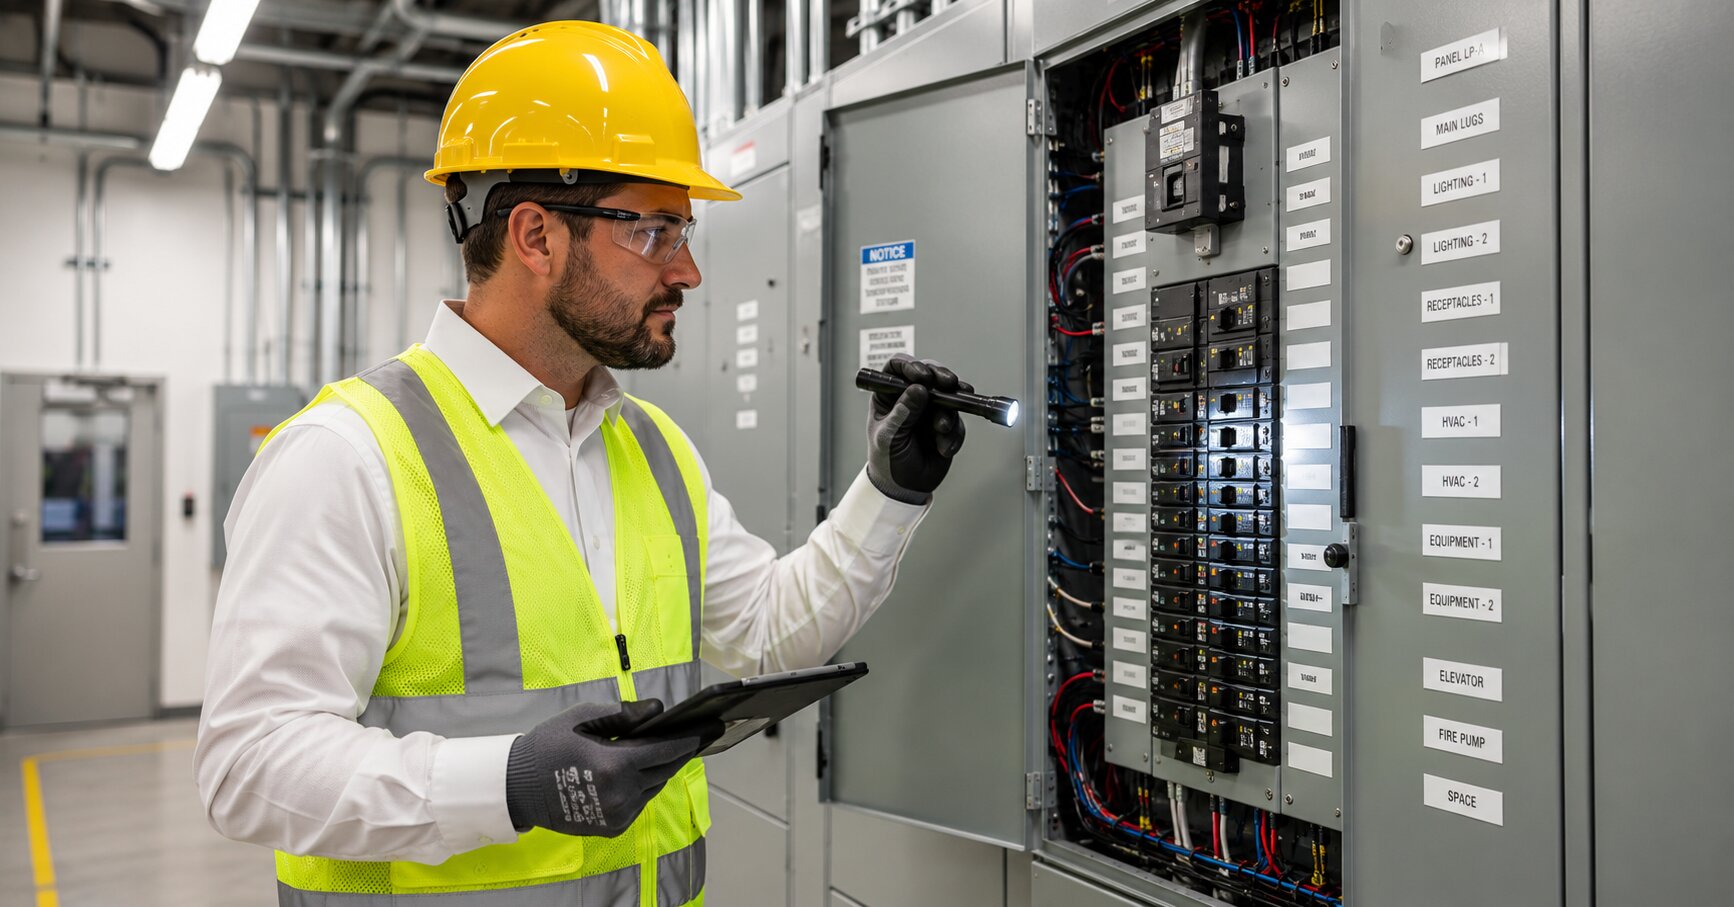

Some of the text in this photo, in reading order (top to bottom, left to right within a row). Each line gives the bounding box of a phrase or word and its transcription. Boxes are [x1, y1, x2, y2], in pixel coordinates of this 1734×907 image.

[1435, 51, 1462, 69] PANEL
[1436, 113, 1483, 135] MAIN LUGS
[1433, 174, 1474, 194] LIGHTING
[1434, 235, 1473, 253] LIGHTING
[1481, 233, 1488, 245] 2
[870, 245, 906, 262] NOTICE
[1427, 294, 1482, 312] RECEPTACLES
[1427, 355, 1482, 369] RECEPTACLES
[1489, 354, 1495, 366] 2
[1443, 416, 1465, 427] HVAC
[1443, 476, 1465, 487] HVAC
[1473, 476, 1480, 488] 2
[1430, 535, 1479, 548] EQUIPMENT
[1430, 593, 1480, 609] EQUIPMENT
[1487, 599, 1494, 612] 2
[1440, 670, 1484, 688] ELEVATOR
[1439, 728, 1485, 749] FIRE PUMP
[1448, 790, 1476, 808] SPACE
